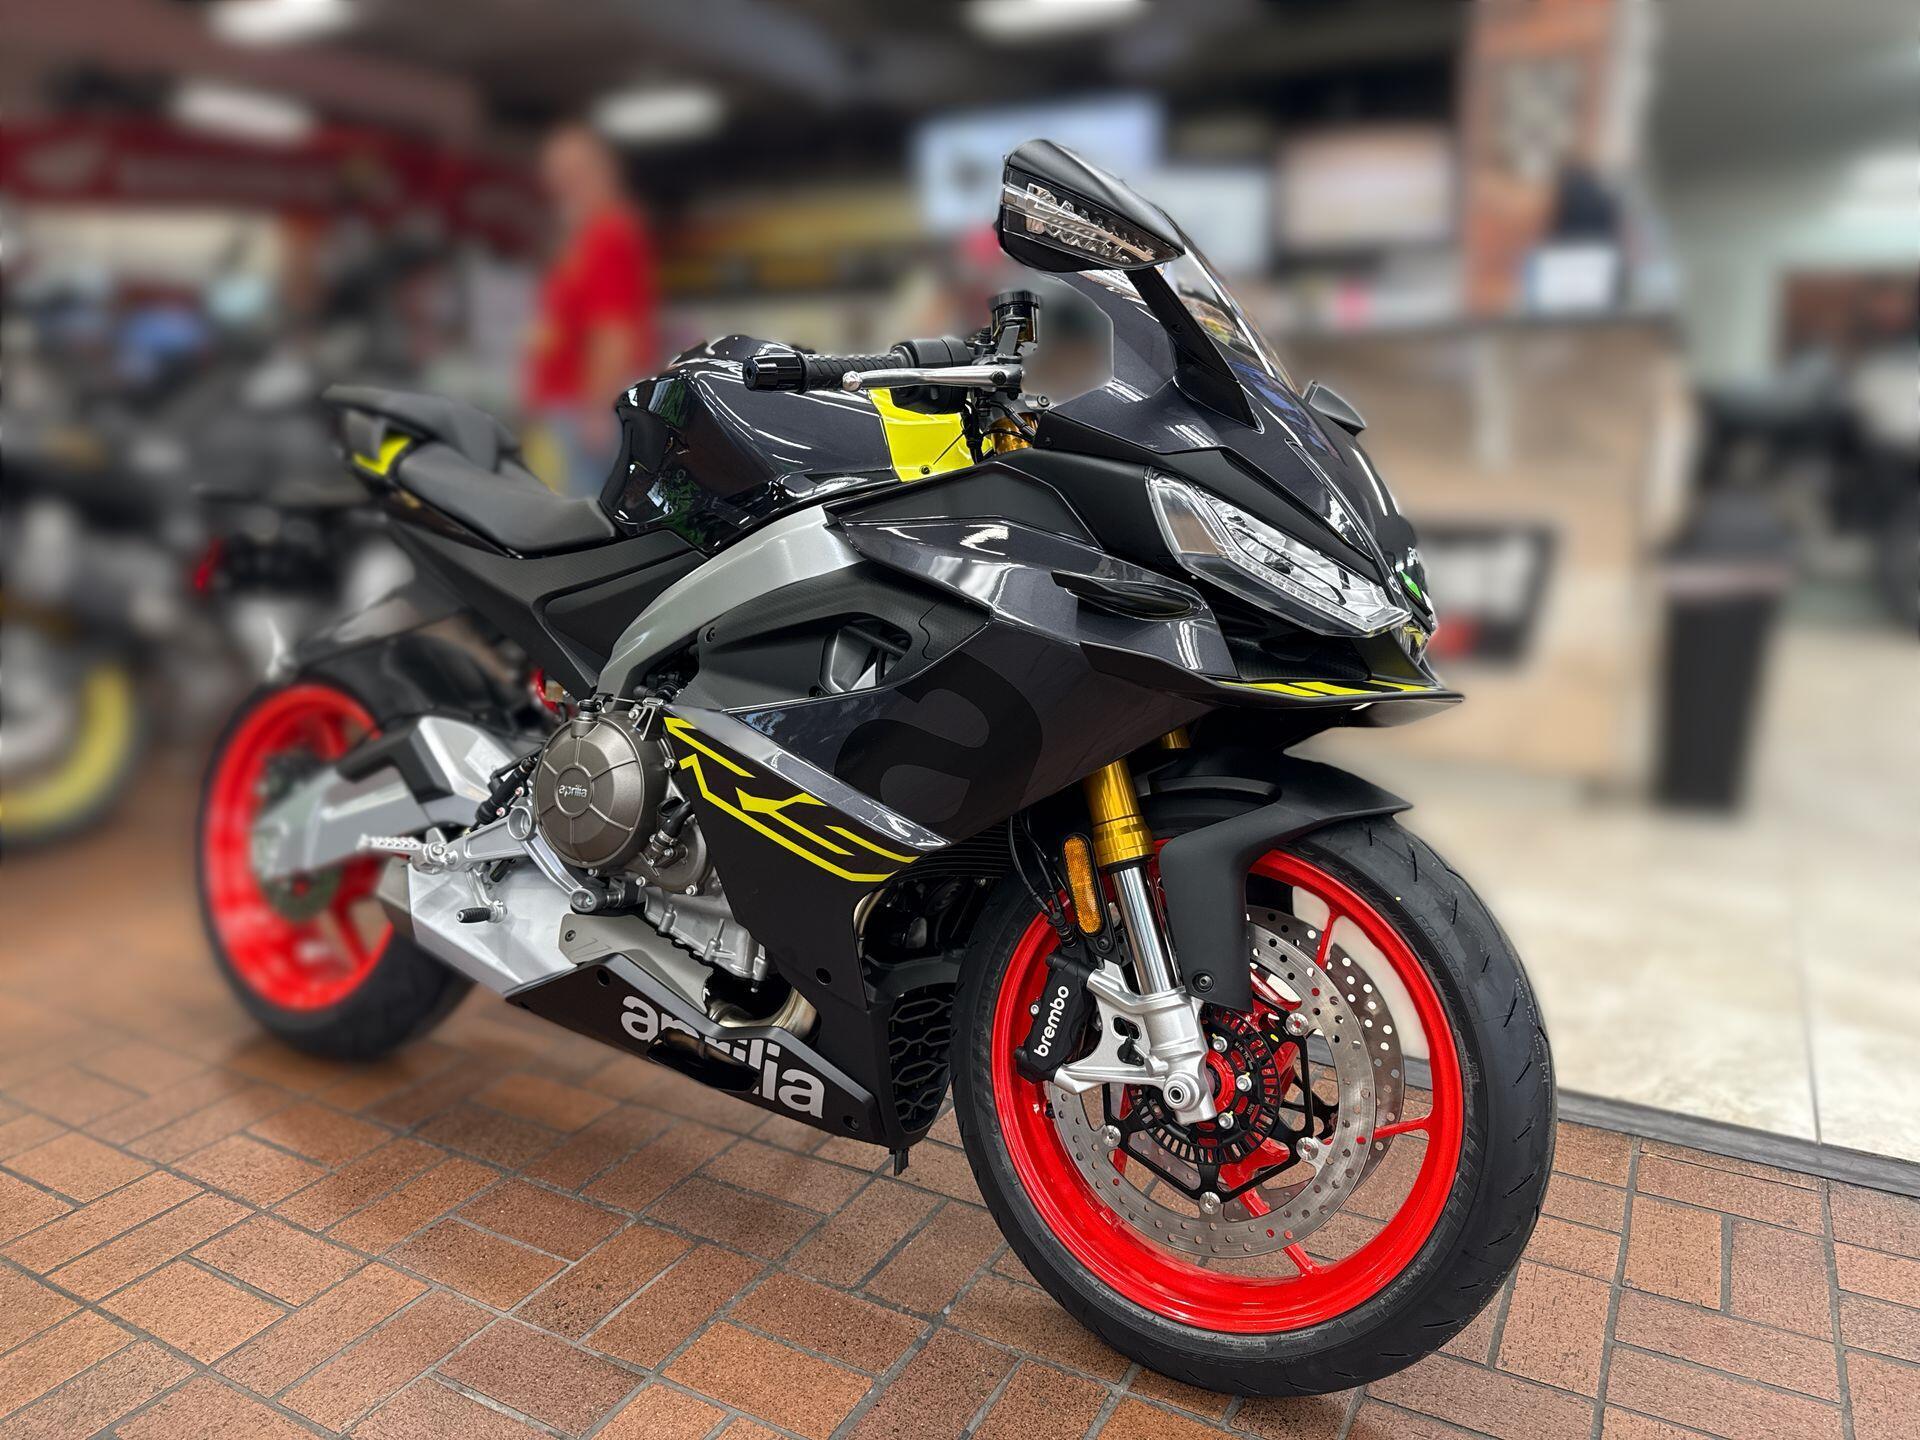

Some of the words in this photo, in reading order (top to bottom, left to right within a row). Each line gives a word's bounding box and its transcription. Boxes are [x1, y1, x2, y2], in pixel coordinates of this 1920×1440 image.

[559, 784, 588, 798] aprilia
[620, 995, 825, 1119] alia
[1033, 985, 1070, 1057] brembo
